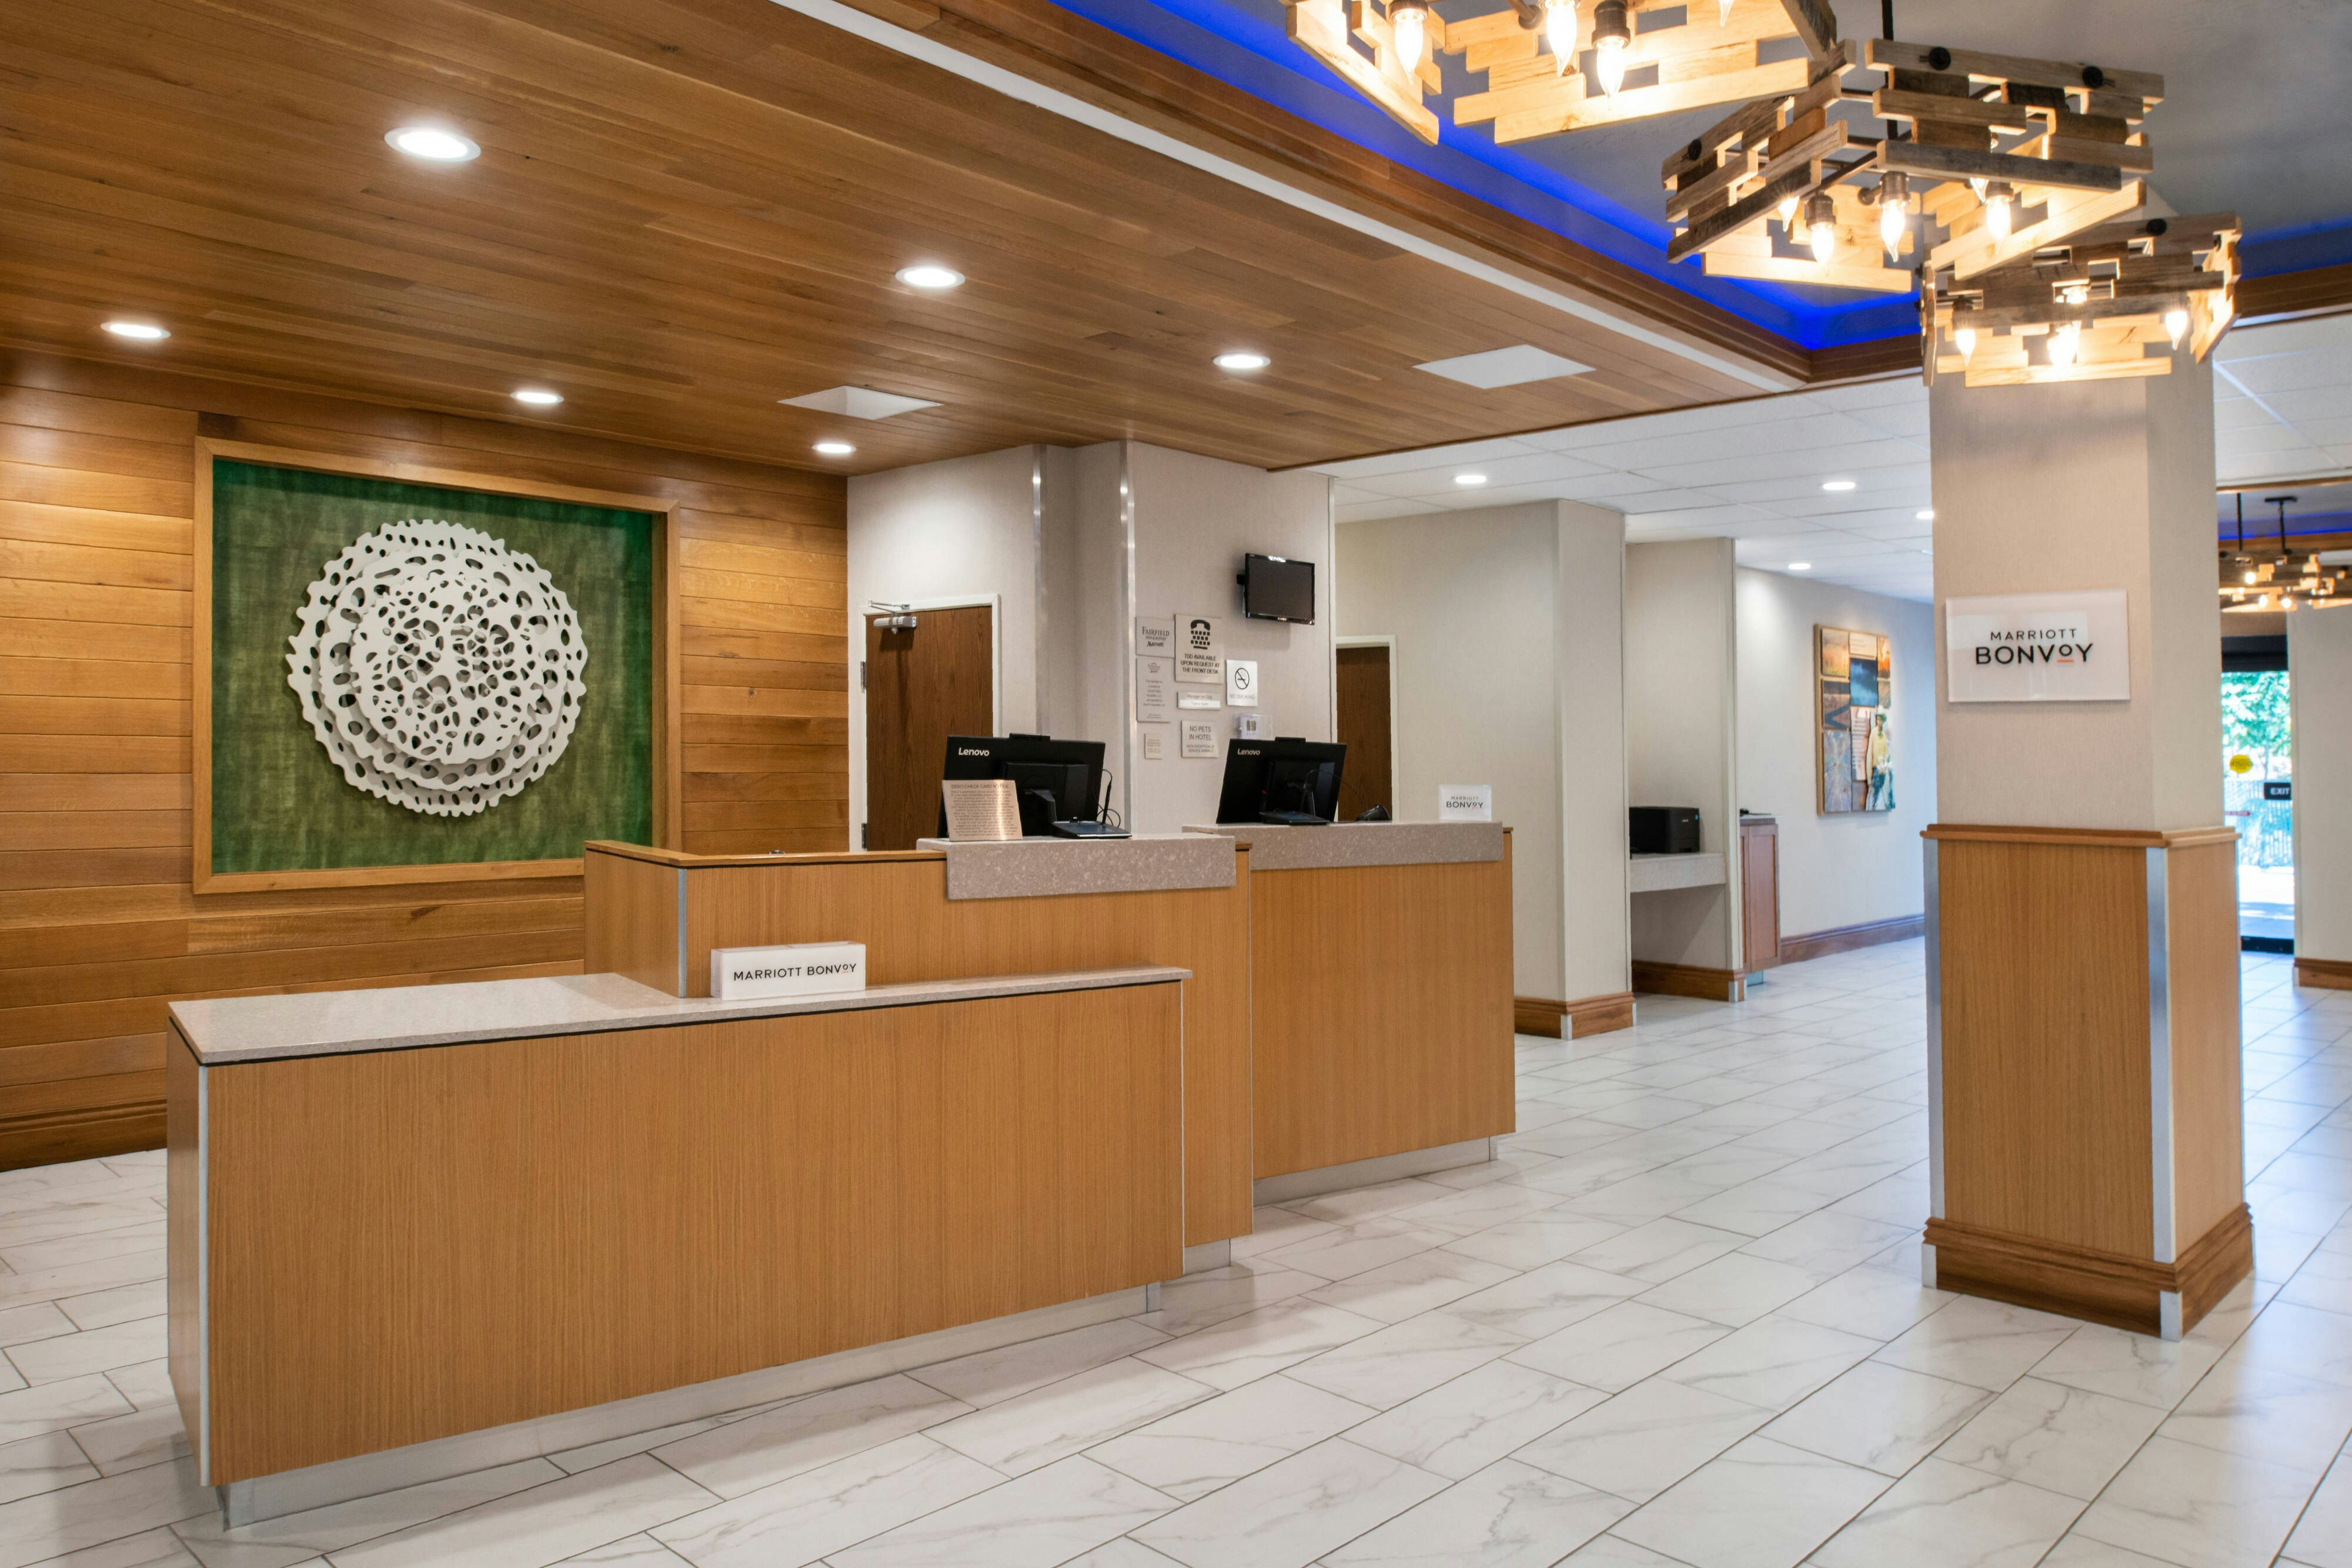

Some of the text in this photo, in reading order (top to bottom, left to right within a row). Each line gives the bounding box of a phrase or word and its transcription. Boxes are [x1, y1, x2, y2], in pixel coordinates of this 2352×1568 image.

[1142, 626, 1170, 637] FAIRFIELD
[1990, 628, 2077, 641] MARRIOTT
[1976, 643, 2093, 665] BONVOY
[958, 747, 990, 757] Lenovo
[734, 963, 857, 981] MARRIOTT BONVOY
